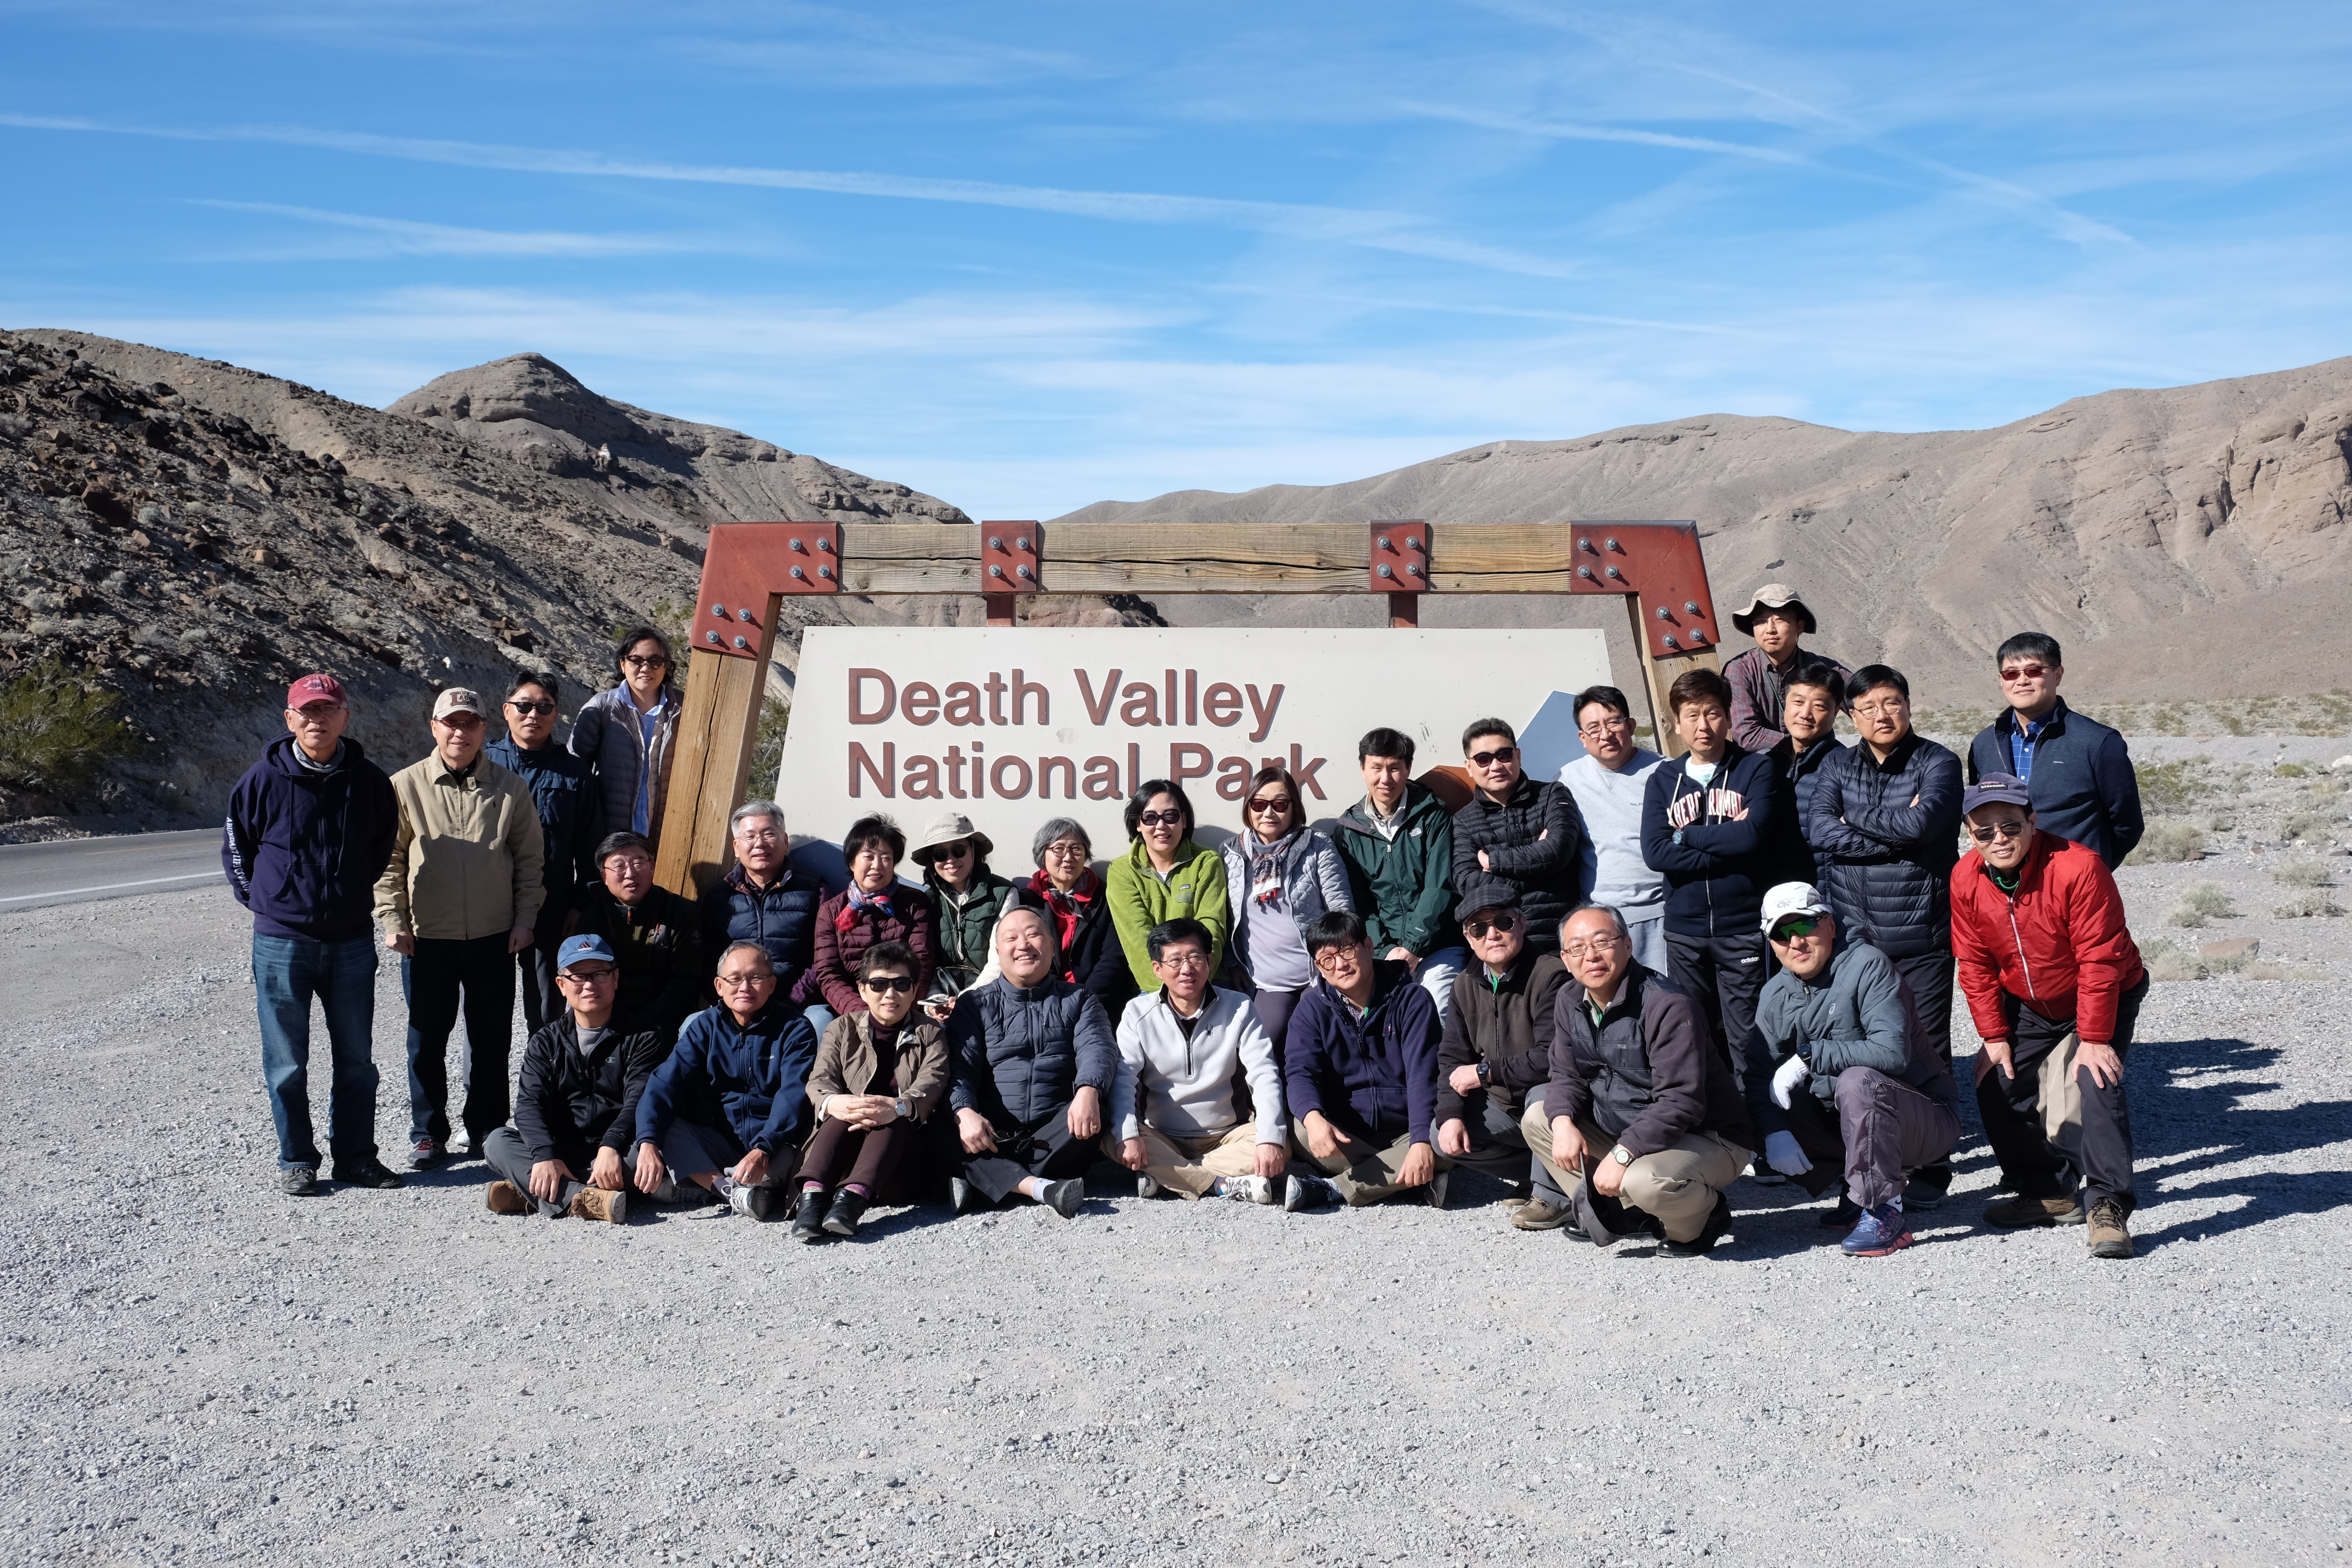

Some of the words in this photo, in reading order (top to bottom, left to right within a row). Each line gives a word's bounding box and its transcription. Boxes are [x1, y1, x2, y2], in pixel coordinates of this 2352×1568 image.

[848, 668, 1050, 726] Death
[1073, 668, 1286, 743] Valley
[848, 741, 1140, 800] National
[226, 816, 239, 855] ABUNDANT
